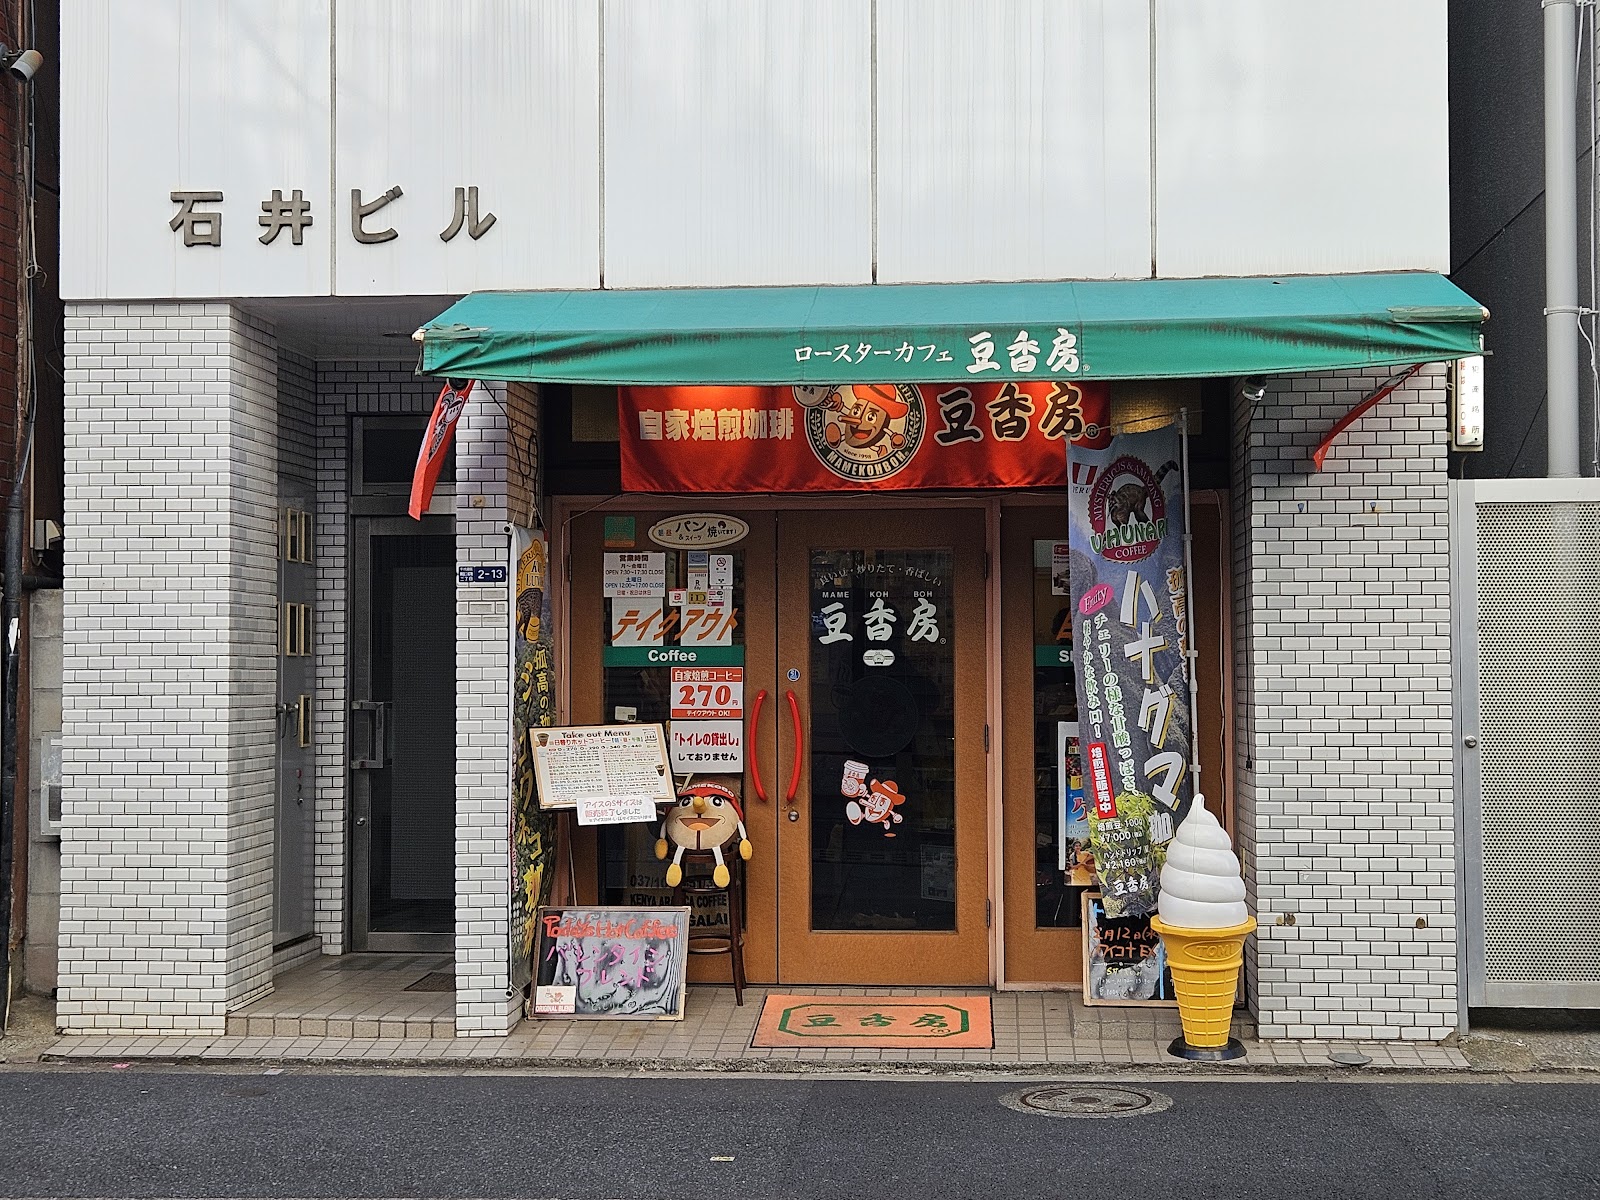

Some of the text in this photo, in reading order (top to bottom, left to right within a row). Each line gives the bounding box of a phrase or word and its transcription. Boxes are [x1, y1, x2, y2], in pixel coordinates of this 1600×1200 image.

[169, 185, 497, 247] 石井ビル
[794, 328, 1081, 374] ロースターカフェ 豆香房
[935, 382, 1086, 446] 豆香房
[638, 408, 794, 441] 自家焙煎珈琲
[675, 520, 707, 533] パン
[1115, 545, 1148, 559] COFFEE
[477, 569, 503, 580] 2-13
[611, 608, 739, 641] テイクアウト
[818, 598, 940, 645] 豆香房
[648, 649, 697, 662] Coffee
[674, 669, 742, 682] 自家焙煎コーヒー
[562, 729, 631, 739] Take out Menu
[678, 753, 738, 761] しておりません
[1113, 874, 1149, 896] 豆香房
[546, 943, 665, 966] バレンタイン
[801, 1012, 949, 1028] 豆香房
